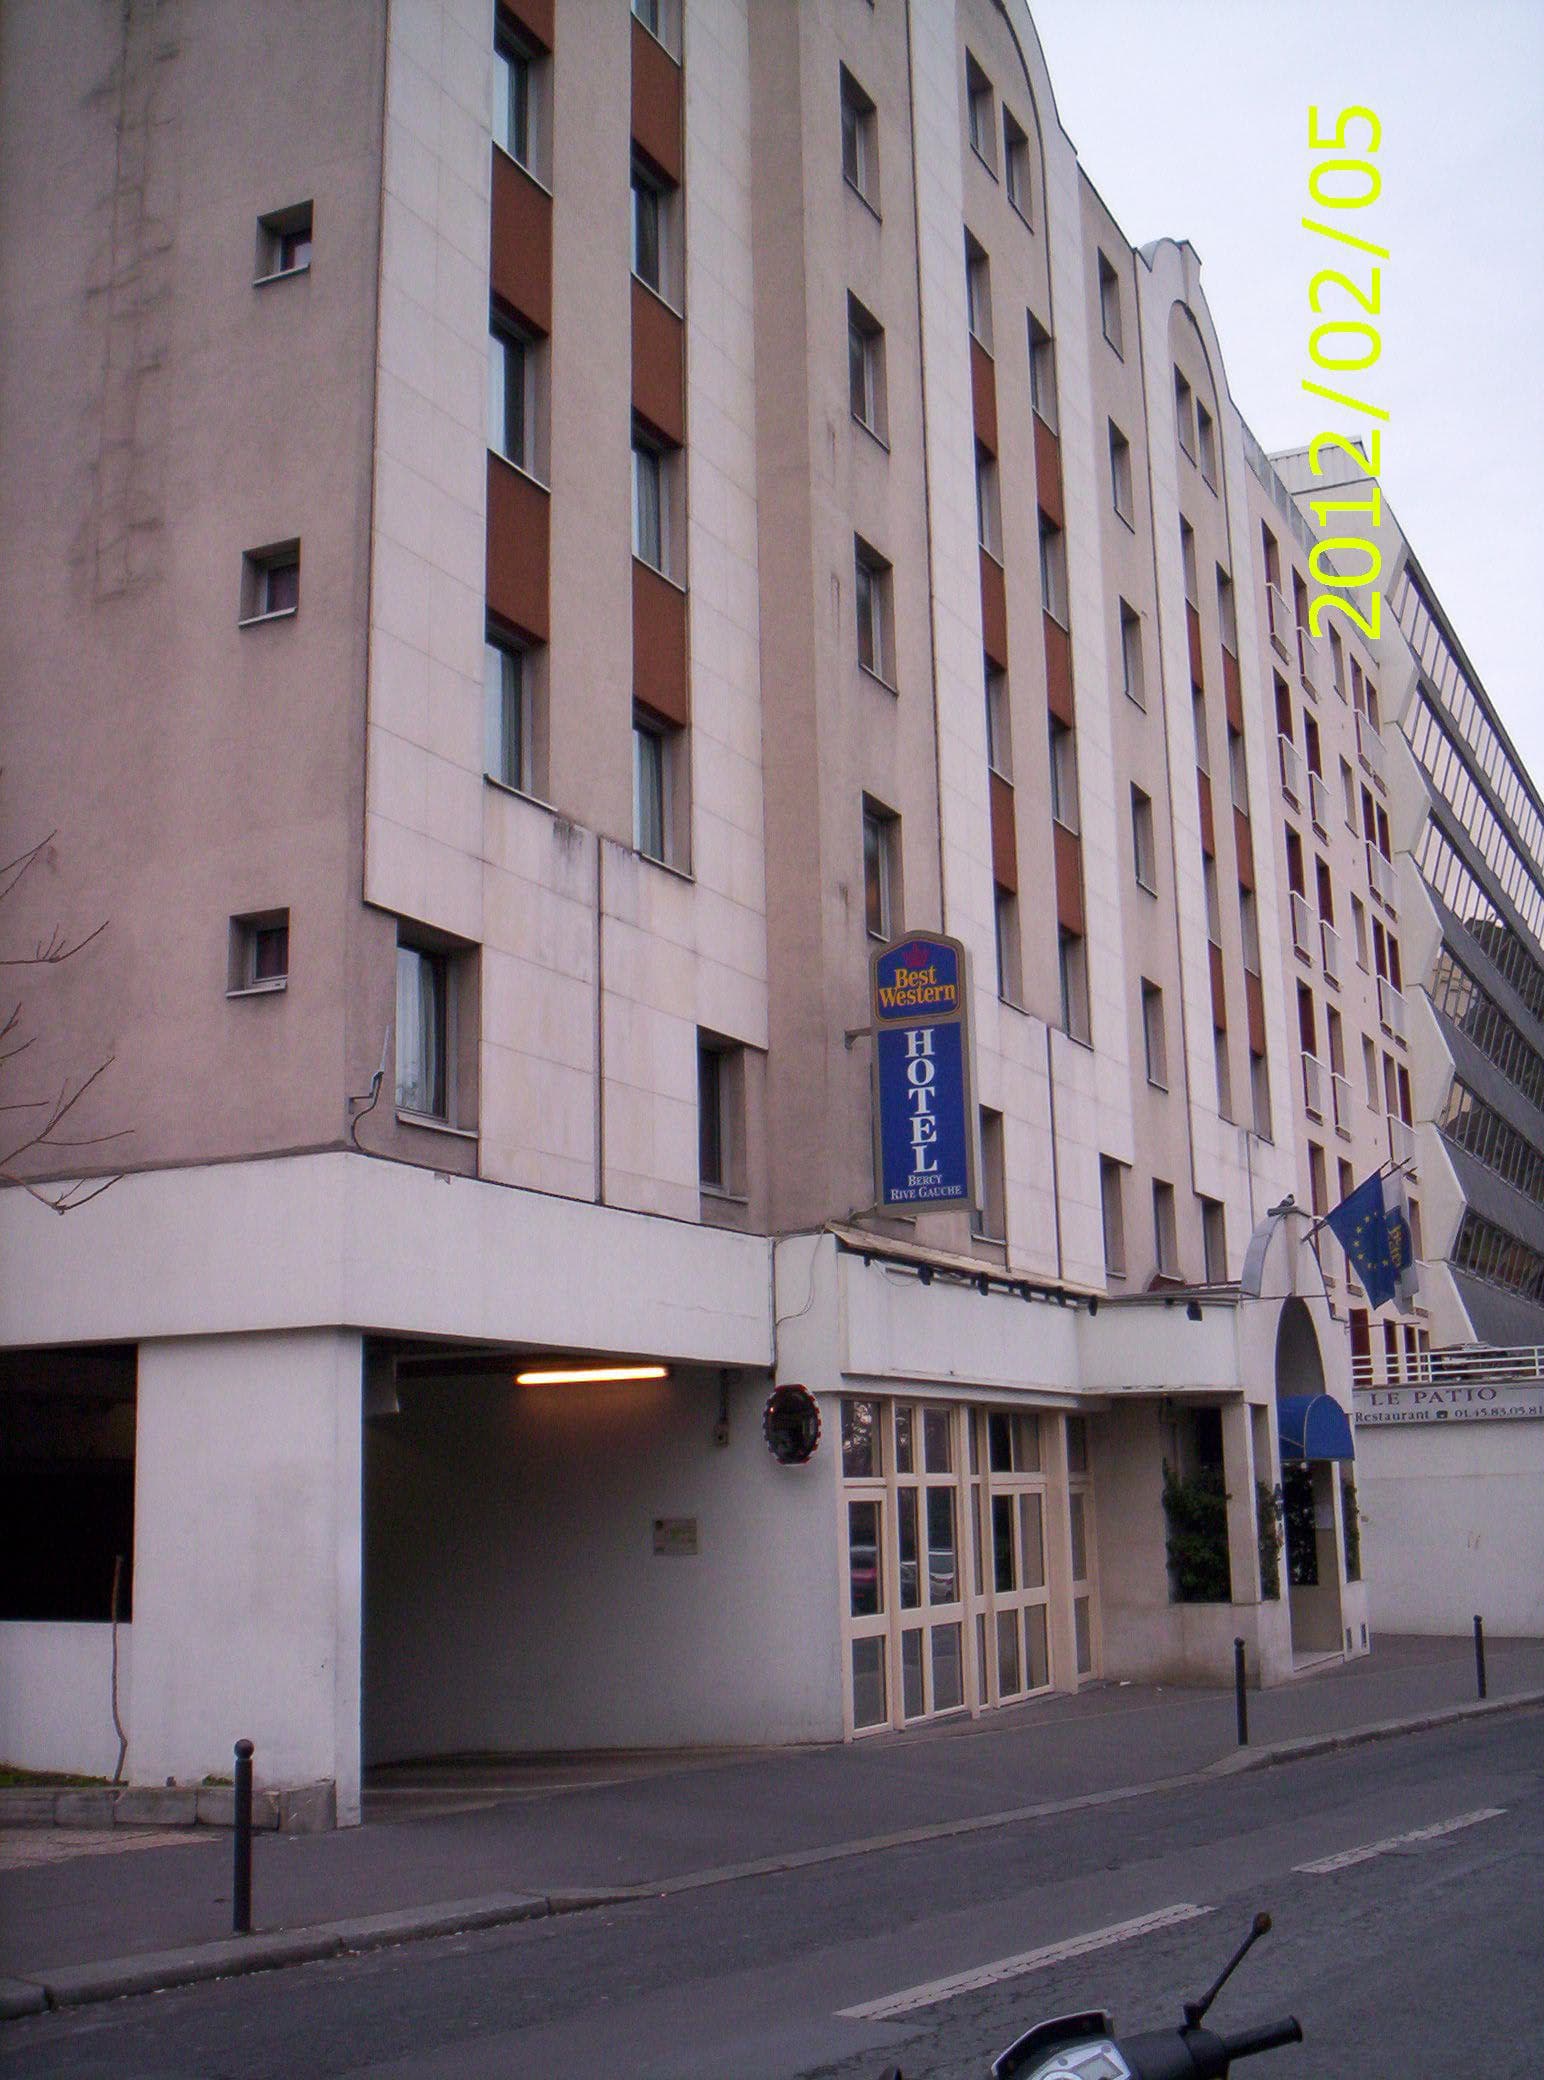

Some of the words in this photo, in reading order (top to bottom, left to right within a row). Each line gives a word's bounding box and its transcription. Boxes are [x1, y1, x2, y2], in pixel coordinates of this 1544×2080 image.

[895, 965, 936, 989] Best
[879, 985, 956, 1008] Western
[904, 1029, 938, 1174] HOTEL
[1370, 1392, 1401, 1406] LE
[1414, 1387, 1497, 1404] PATIO
[1355, 1410, 1430, 1423] Restaurant
